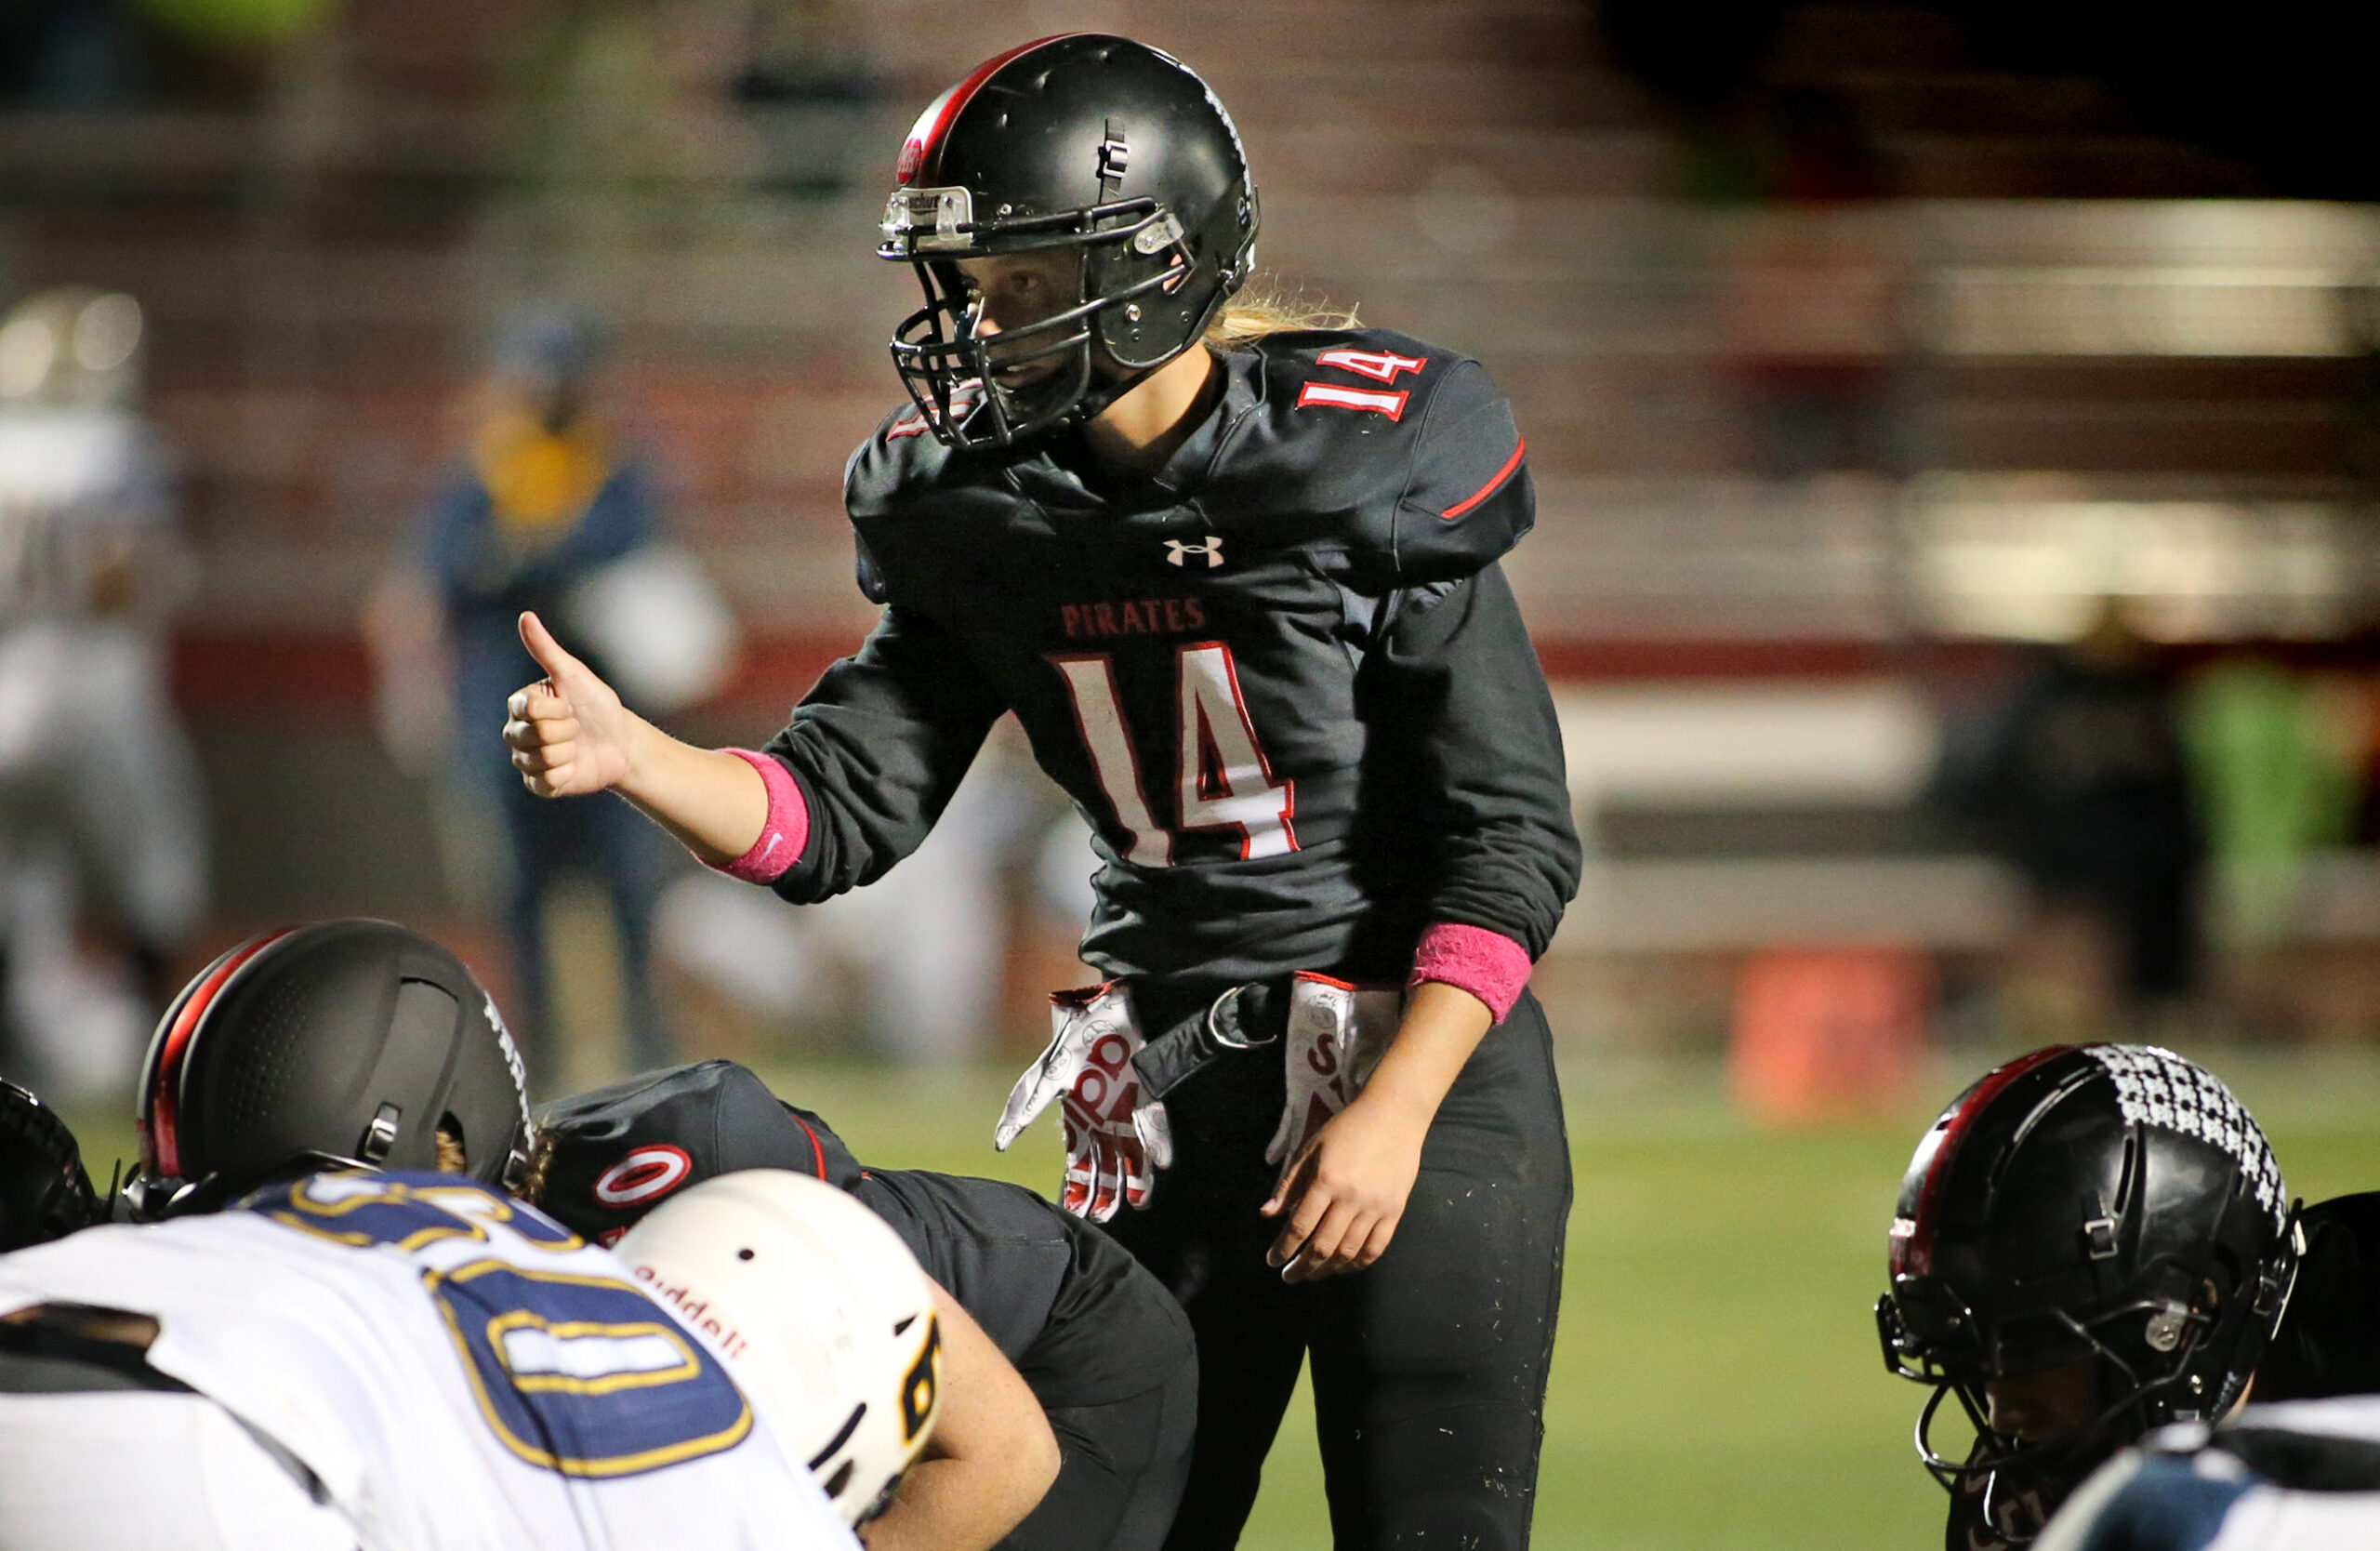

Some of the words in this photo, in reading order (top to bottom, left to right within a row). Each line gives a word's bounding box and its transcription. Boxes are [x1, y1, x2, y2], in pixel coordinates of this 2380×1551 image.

[1294, 348, 1429, 422] 14
[1062, 598, 1206, 636] PIRATES
[1040, 640, 1301, 868] 14
